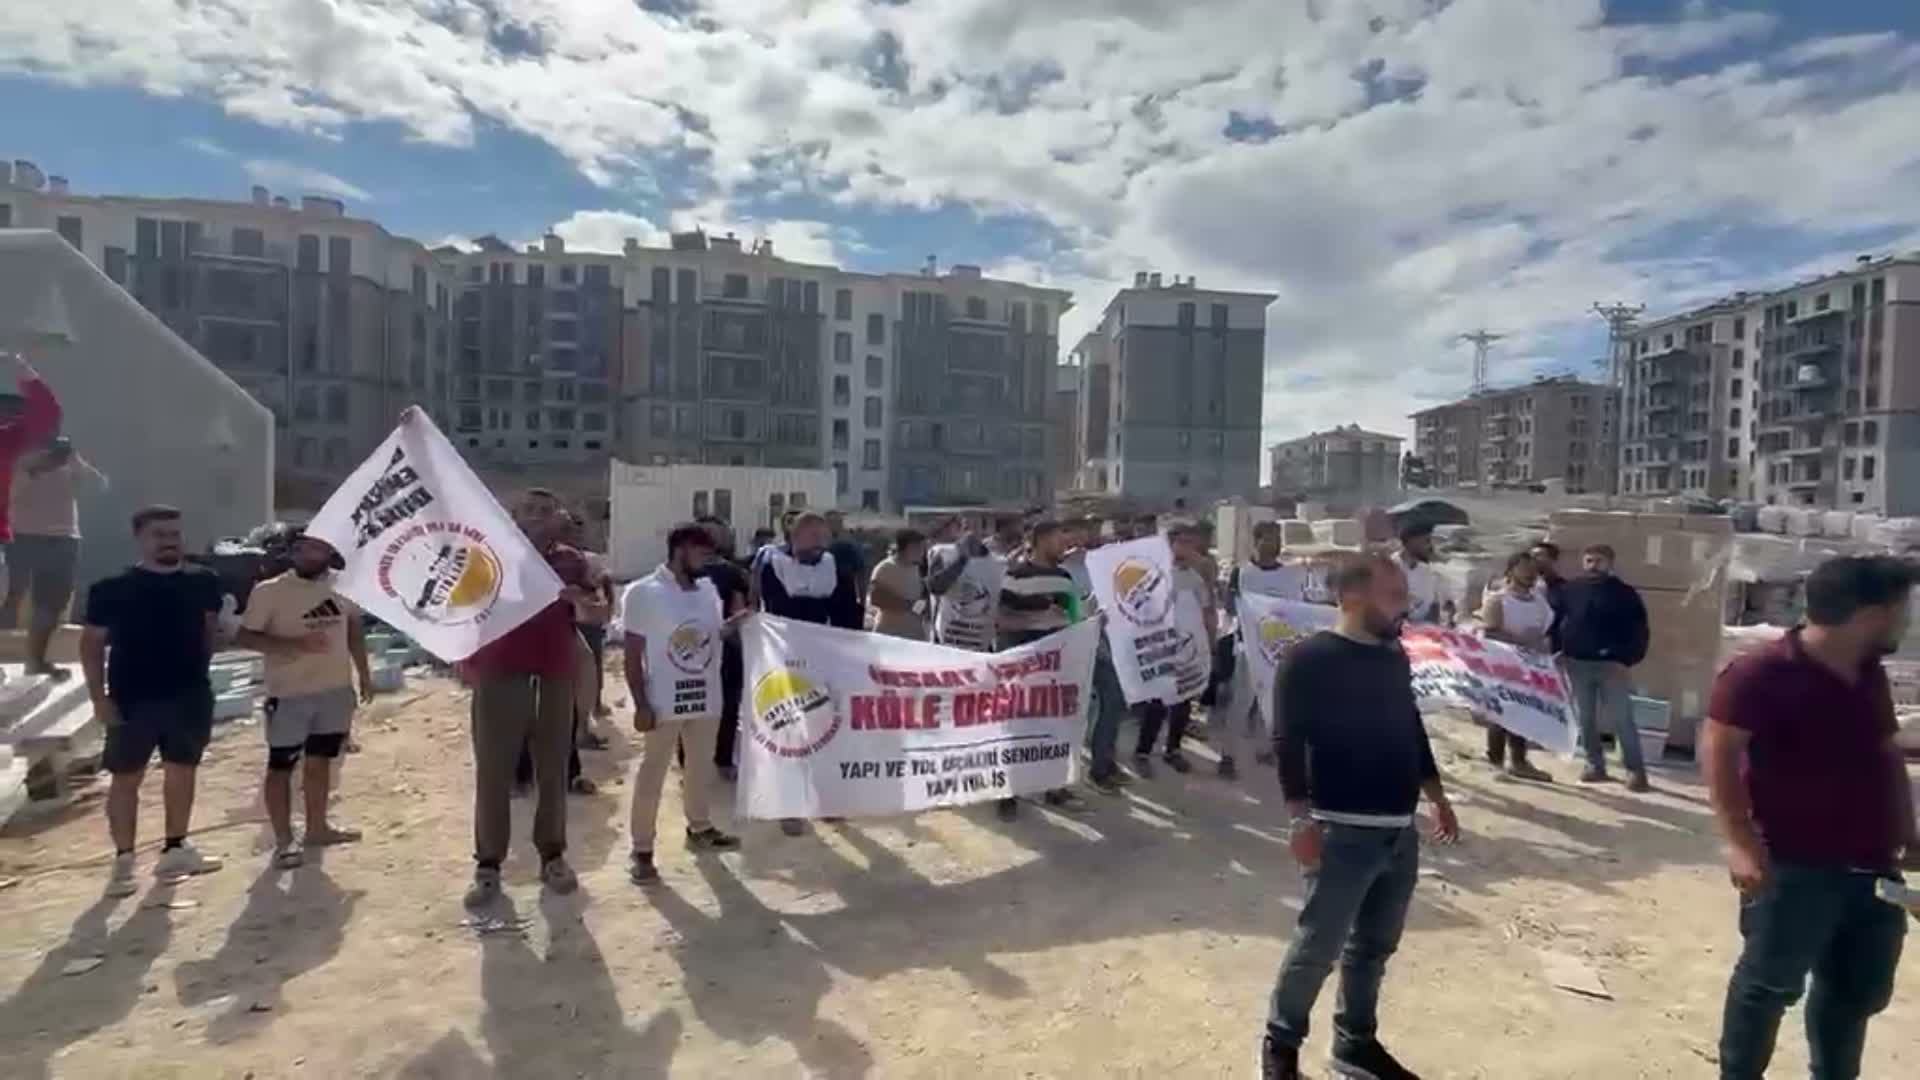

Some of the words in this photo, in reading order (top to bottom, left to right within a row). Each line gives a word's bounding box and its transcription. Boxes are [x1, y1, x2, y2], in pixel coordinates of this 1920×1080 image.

[851, 690, 942, 730] KÖLE
[840, 761, 880, 779] YAPI
[886, 760, 905, 776] VE
[1001, 742, 1070, 765] SENDİKASI
